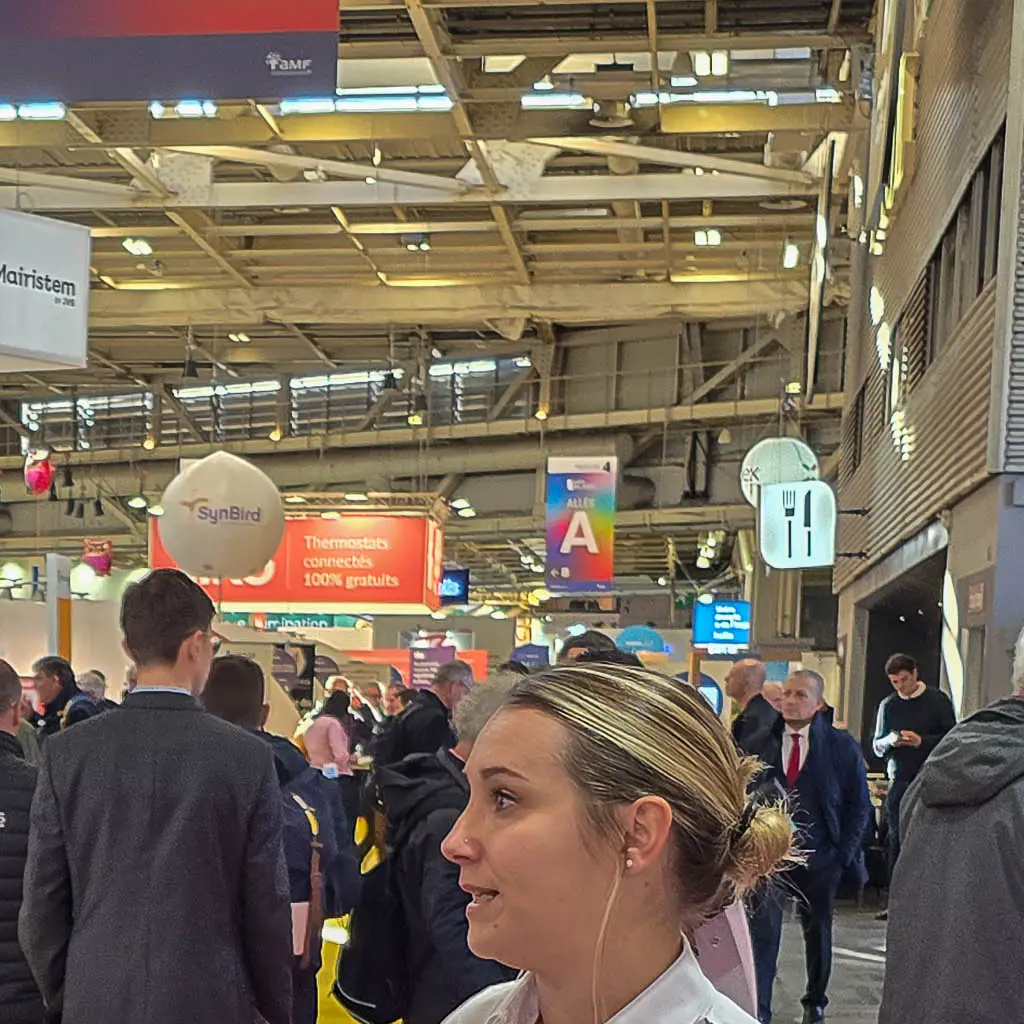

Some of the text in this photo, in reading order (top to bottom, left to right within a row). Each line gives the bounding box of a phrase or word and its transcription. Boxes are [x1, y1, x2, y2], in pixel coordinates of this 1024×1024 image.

[197, 506, 262, 524] SynBird
[559, 510, 600, 554] A
[303, 535, 389, 550] Thermostats
[303, 554, 373, 569] connectés
[303, 573, 400, 589] 100% gratuits
